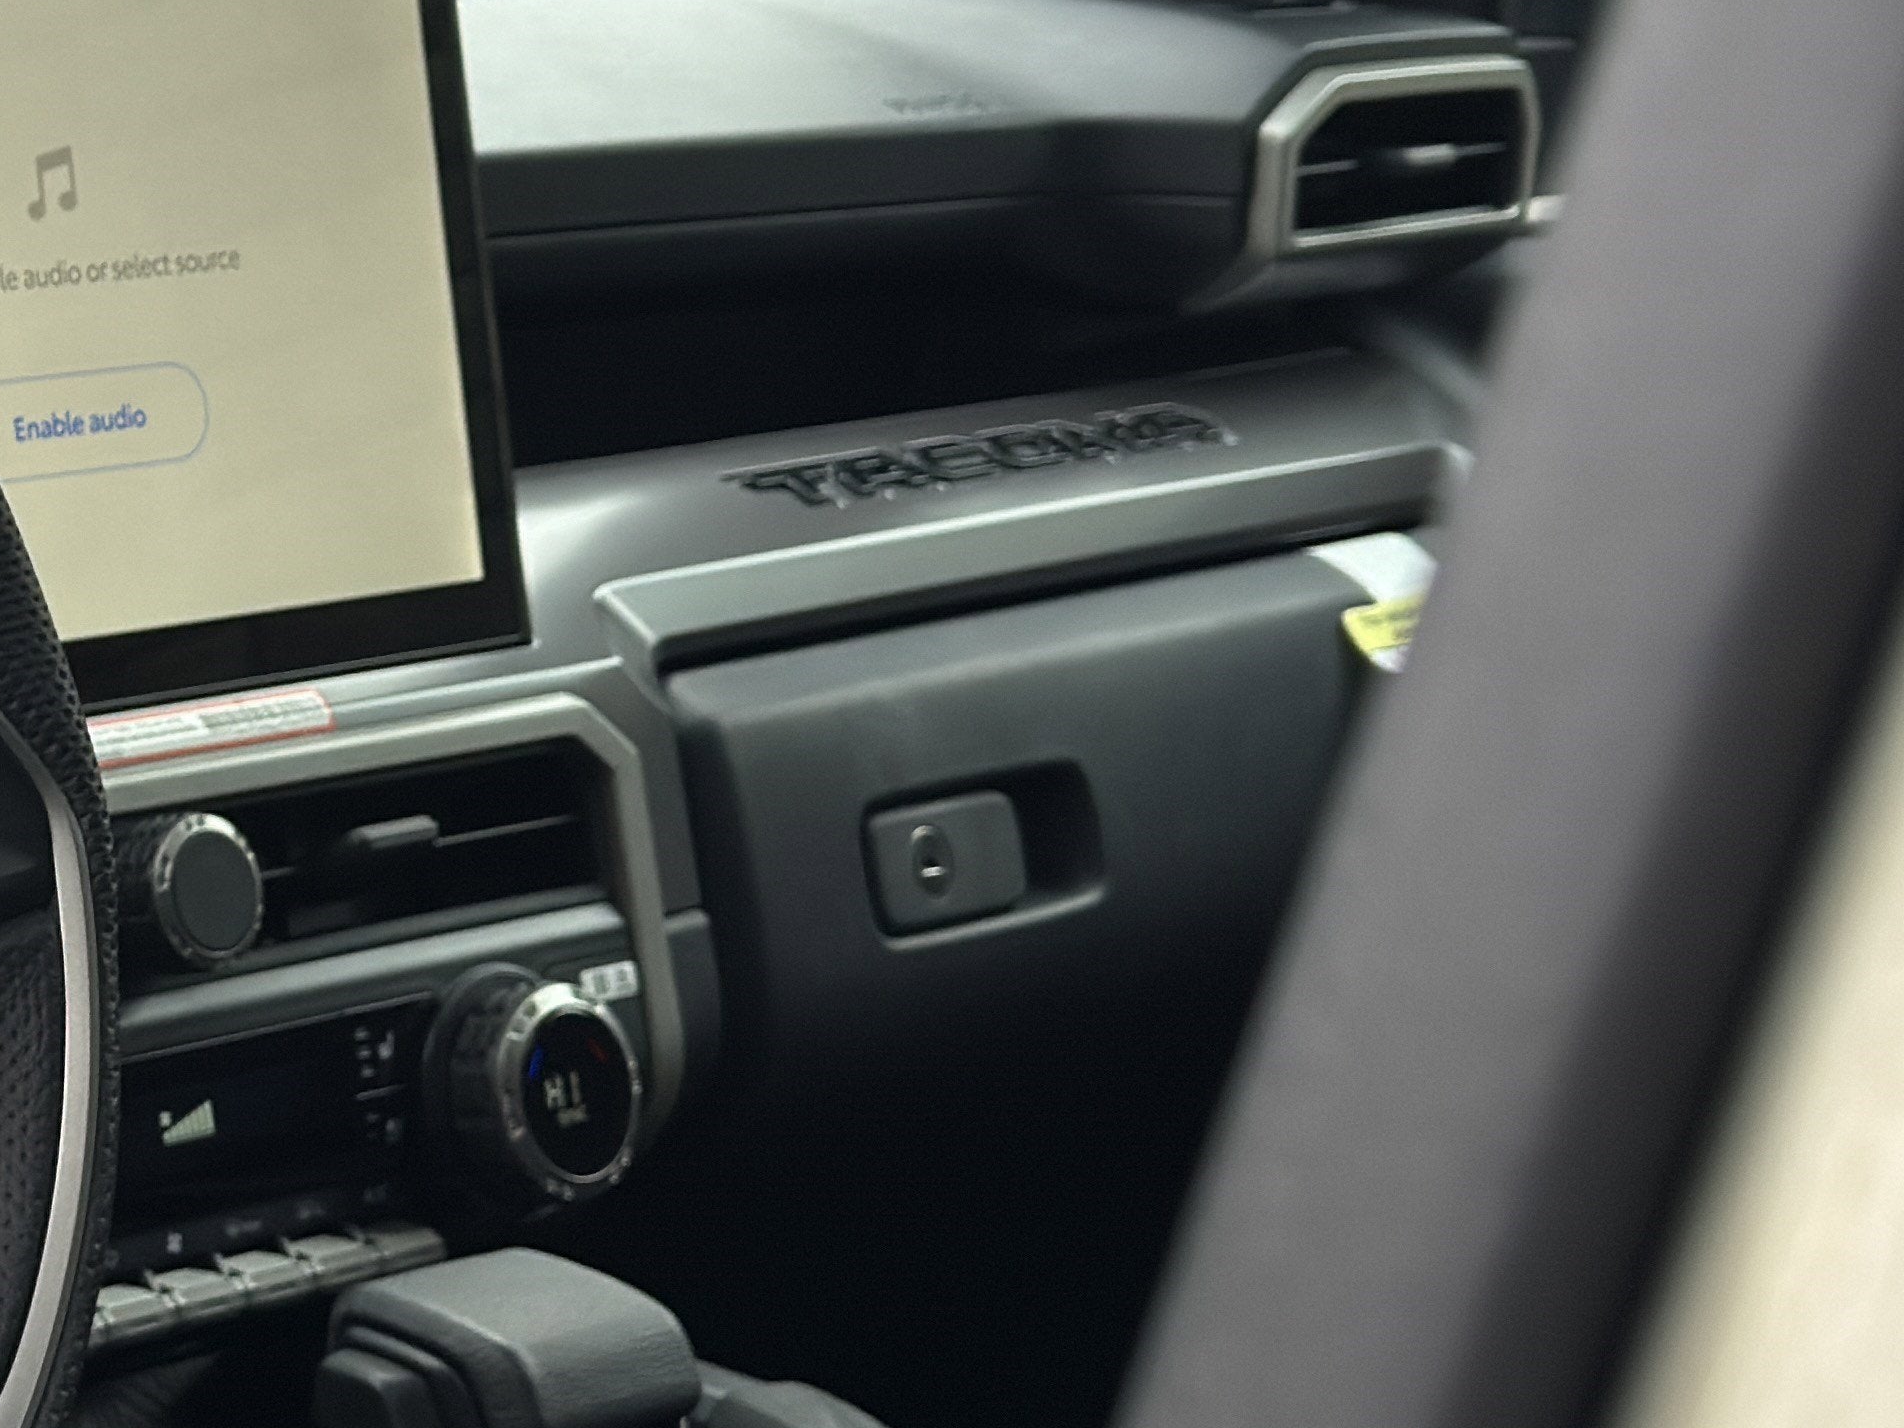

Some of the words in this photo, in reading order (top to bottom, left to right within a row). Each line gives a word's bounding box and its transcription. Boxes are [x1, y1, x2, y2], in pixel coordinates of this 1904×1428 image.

[23, 260, 82, 289] audio
[86, 261, 109, 283] or
[111, 252, 170, 281] select
[175, 248, 242, 274] source
[13, 410, 85, 443] Enable
[89, 403, 148, 431] audio
